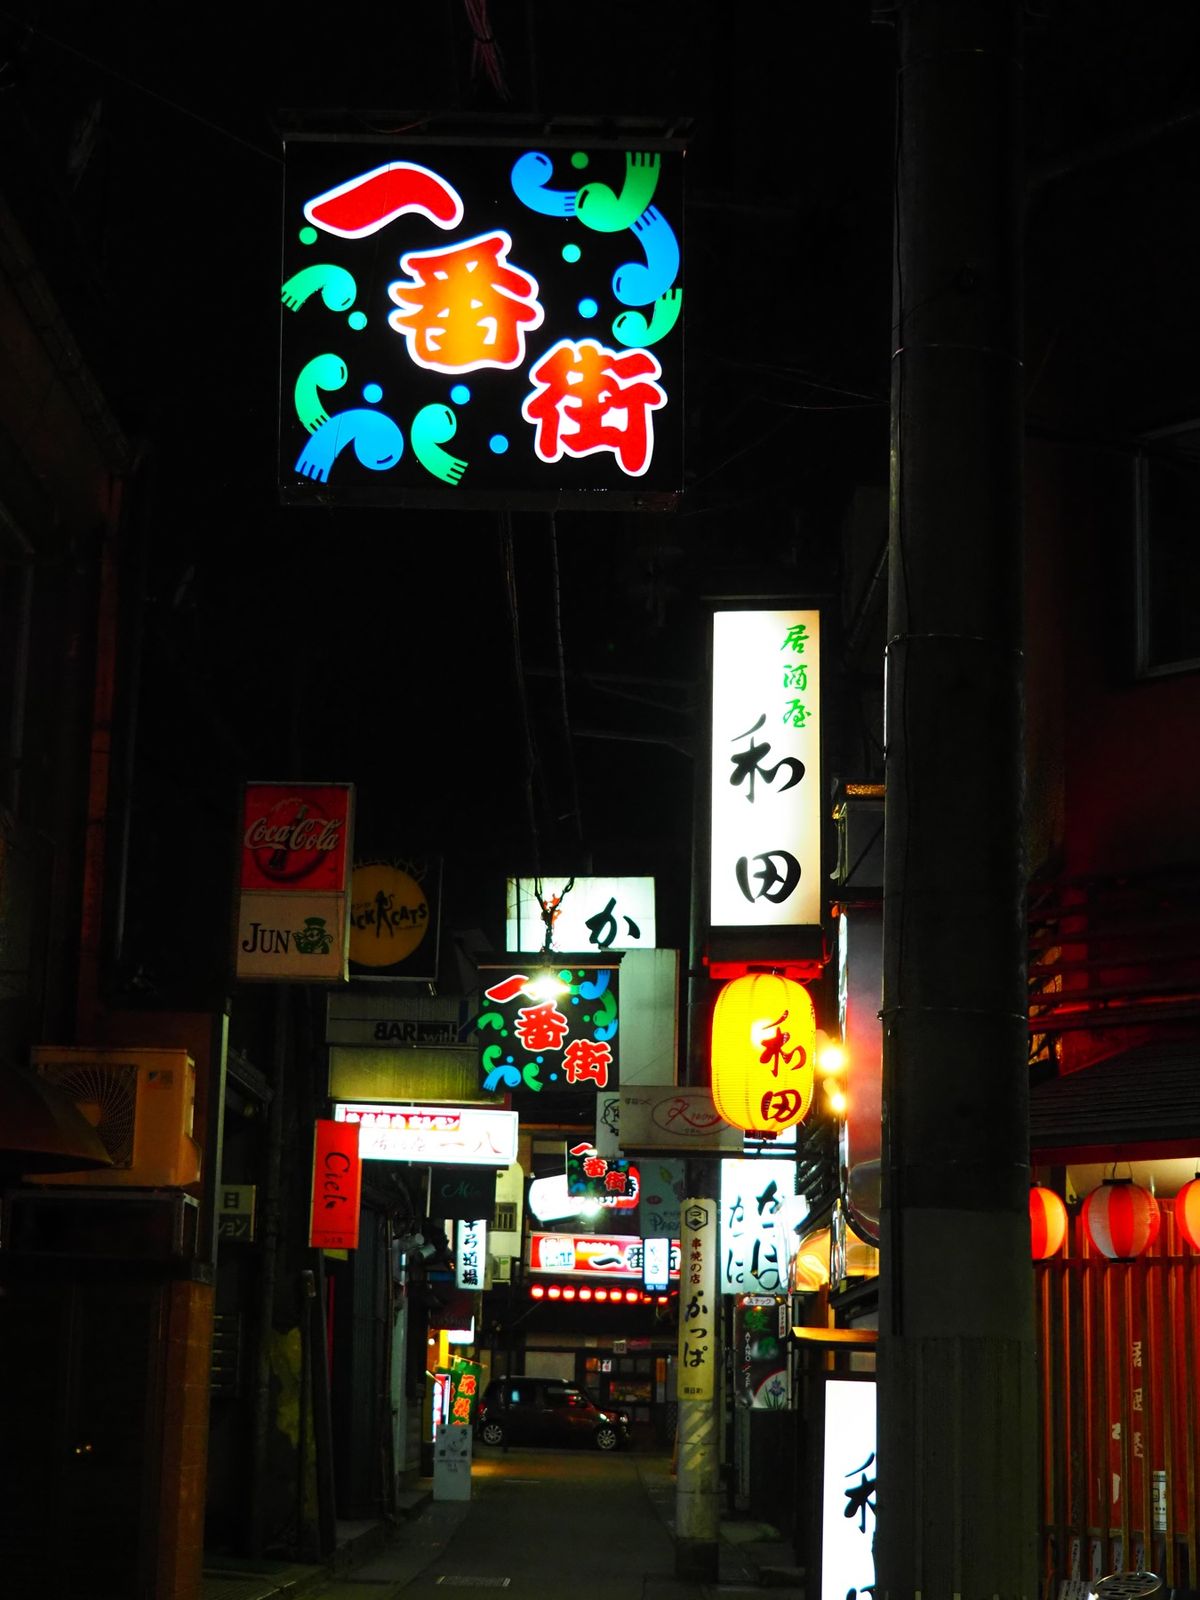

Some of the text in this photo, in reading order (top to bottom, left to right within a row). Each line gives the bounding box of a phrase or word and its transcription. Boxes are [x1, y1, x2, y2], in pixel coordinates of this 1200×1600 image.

[304, 161, 668, 477] 一番街
[780, 623, 812, 728] 居酒屋
[243, 816, 344, 852] Coca-Cola
[729, 712, 806, 904] 和田
[391, 902, 428, 926] CATS
[374, 1021, 416, 1041] BAR
[484, 973, 614, 1089] 一番街
[759, 1009, 807, 1122] 和田
[569, 1142, 628, 1194] 一番街
